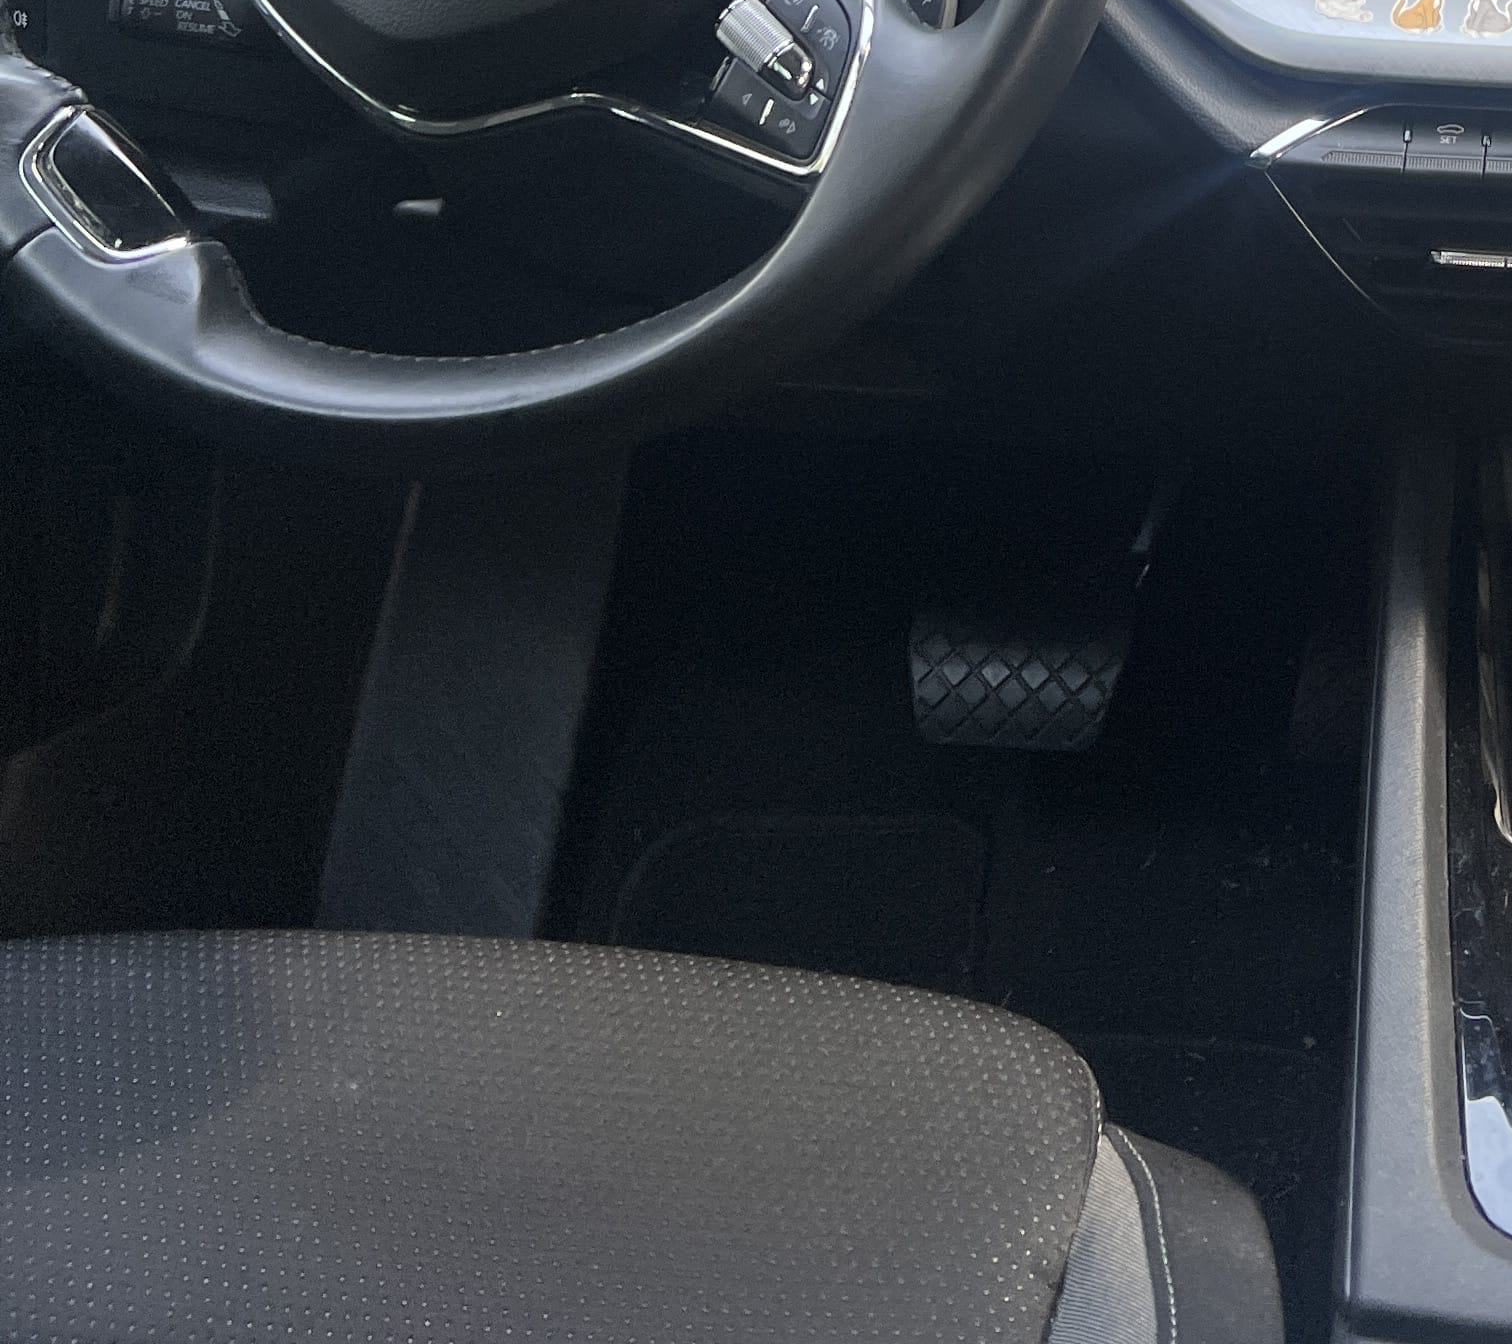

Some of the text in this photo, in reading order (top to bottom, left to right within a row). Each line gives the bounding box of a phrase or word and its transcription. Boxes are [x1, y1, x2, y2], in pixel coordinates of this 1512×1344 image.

[174, 0, 211, 11] CANCEL
[175, 11, 193, 20] ON
[1440, 136, 1457, 144] SET
